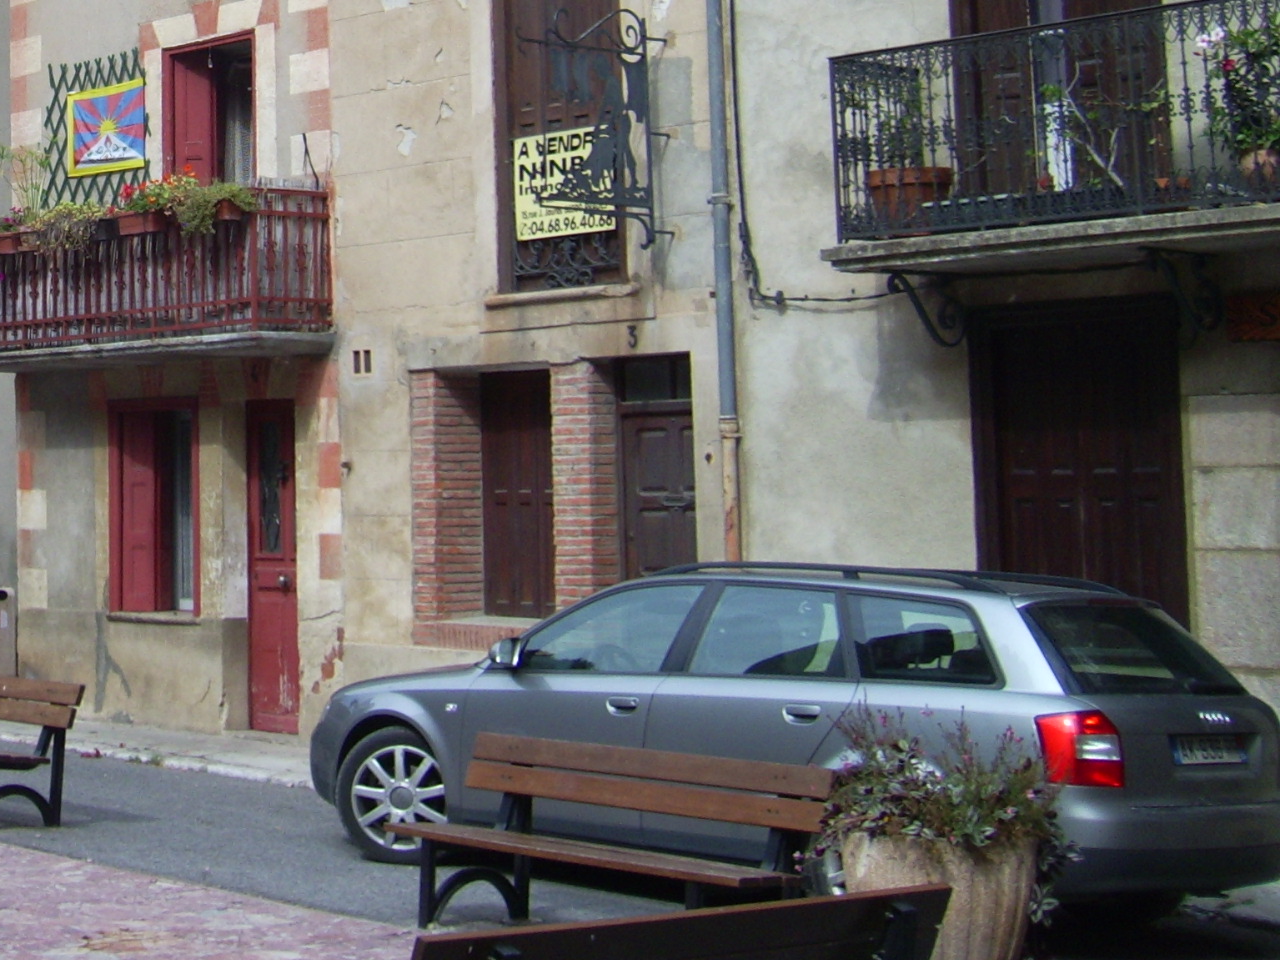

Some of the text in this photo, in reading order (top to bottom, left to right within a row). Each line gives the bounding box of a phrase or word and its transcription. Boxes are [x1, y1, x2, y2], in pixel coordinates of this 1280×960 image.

[517, 131, 600, 160] A VENDR
[627, 325, 638, 349] 3
